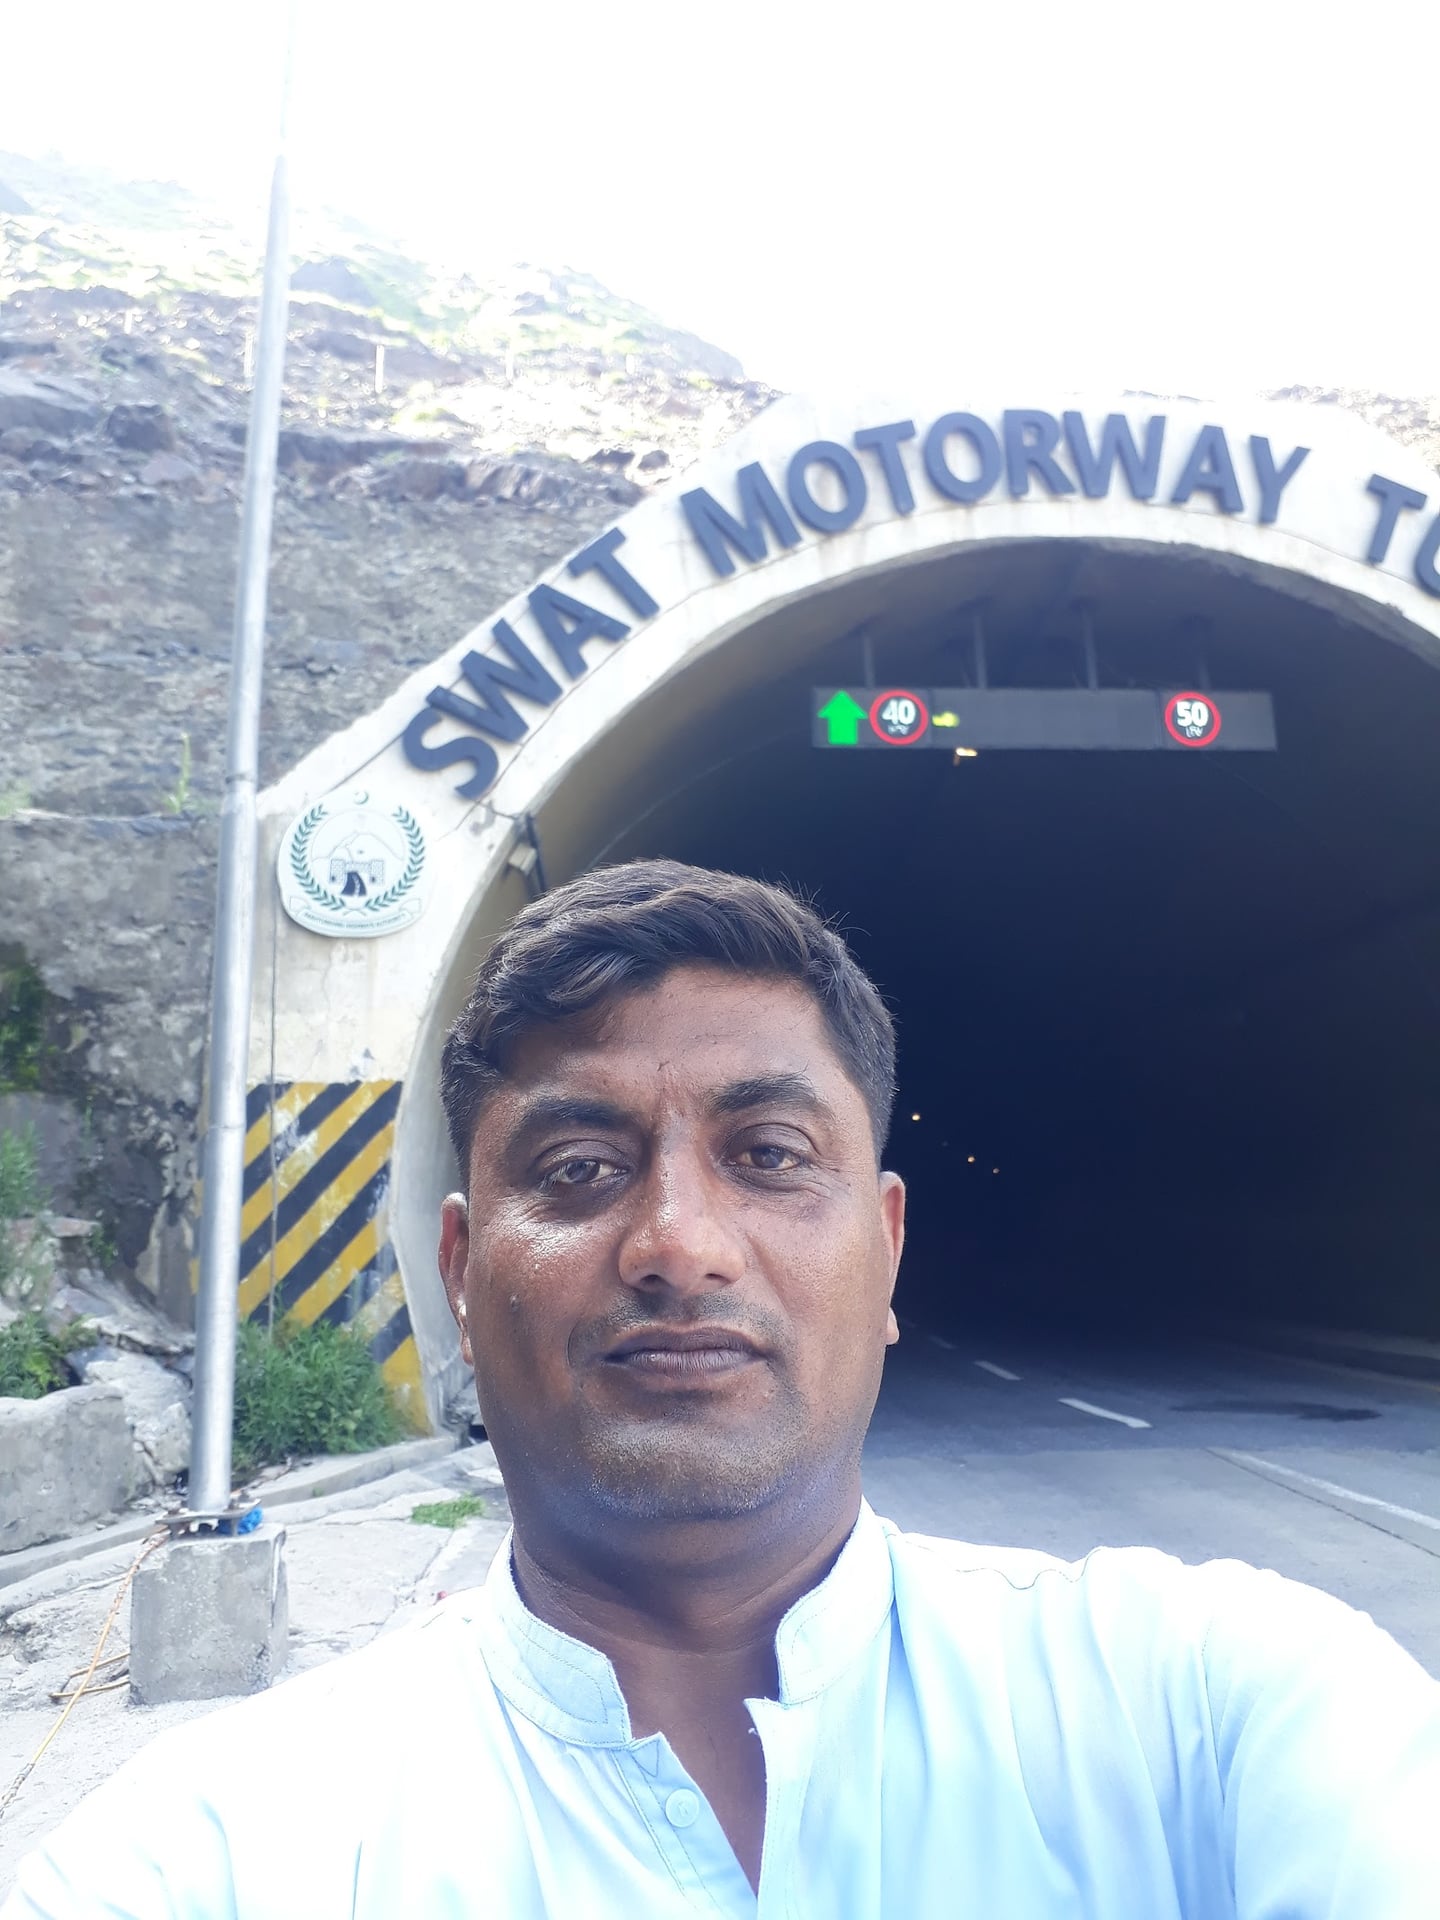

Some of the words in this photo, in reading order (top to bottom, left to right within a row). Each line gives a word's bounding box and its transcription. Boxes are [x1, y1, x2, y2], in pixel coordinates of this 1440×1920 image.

[402, 527, 660, 799] SWAT
[680, 409, 1310, 577] MOTORWAY
[1366, 473, 1440, 599] T
[881, 698, 916, 725] 40
[1176, 701, 1209, 727] 50
